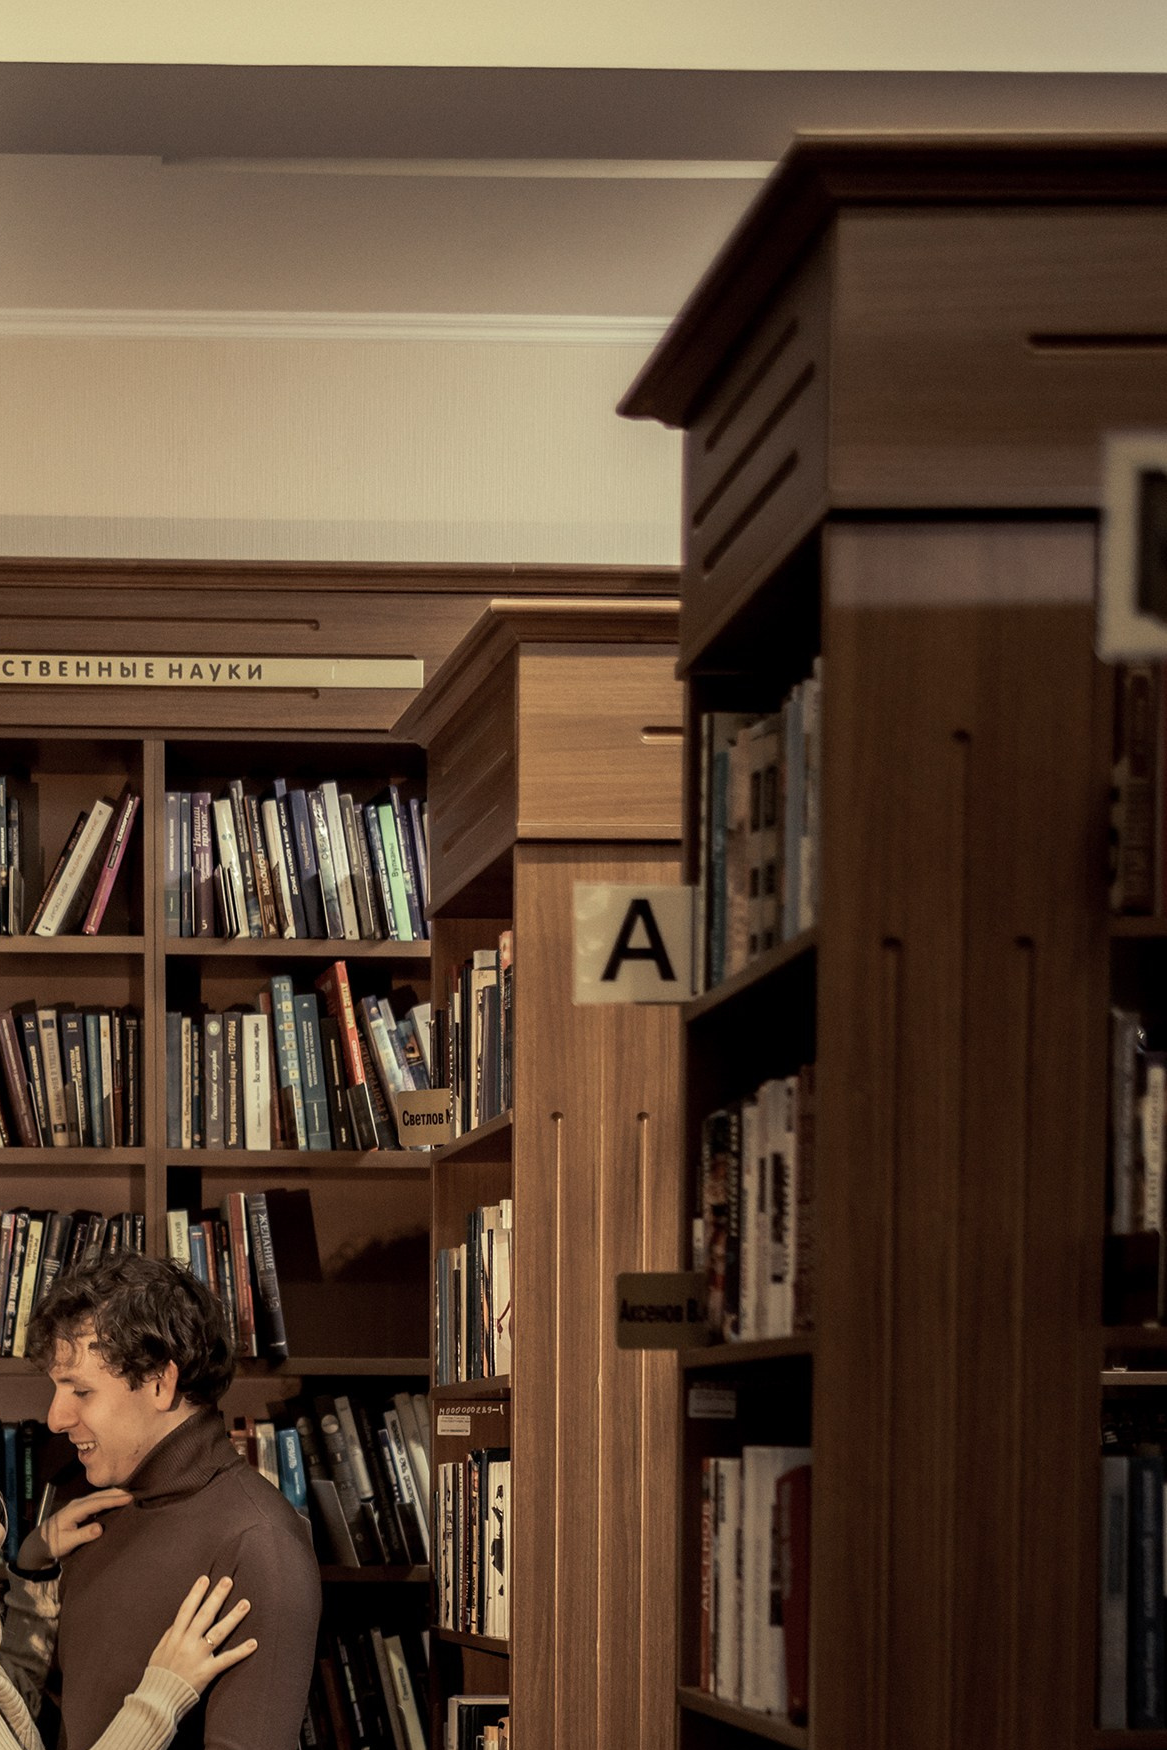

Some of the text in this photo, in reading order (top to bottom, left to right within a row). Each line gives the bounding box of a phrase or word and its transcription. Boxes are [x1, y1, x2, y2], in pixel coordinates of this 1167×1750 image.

[168, 663, 264, 681] НАУКИ
[278, 801, 298, 895] ДОНАТ НАУМОВ МИР ОКЕАНА
[386, 841, 399, 877] Вулканы
[255, 848, 270, 896] ГЕОЛОГИЯ
[601, 898, 677, 982] А
[227, 1020, 236, 1054] ГЕОГРАФЫ
[402, 1110, 443, 1126] Светлов
[253, 1236, 265, 1271] ГОРОДОМ
[258, 1212, 274, 1270] ЖЕЛАНИЕ
[285, 1435, 298, 1468] ИЗРАИЛЬ
[397, 1666, 410, 1701] Генетика
